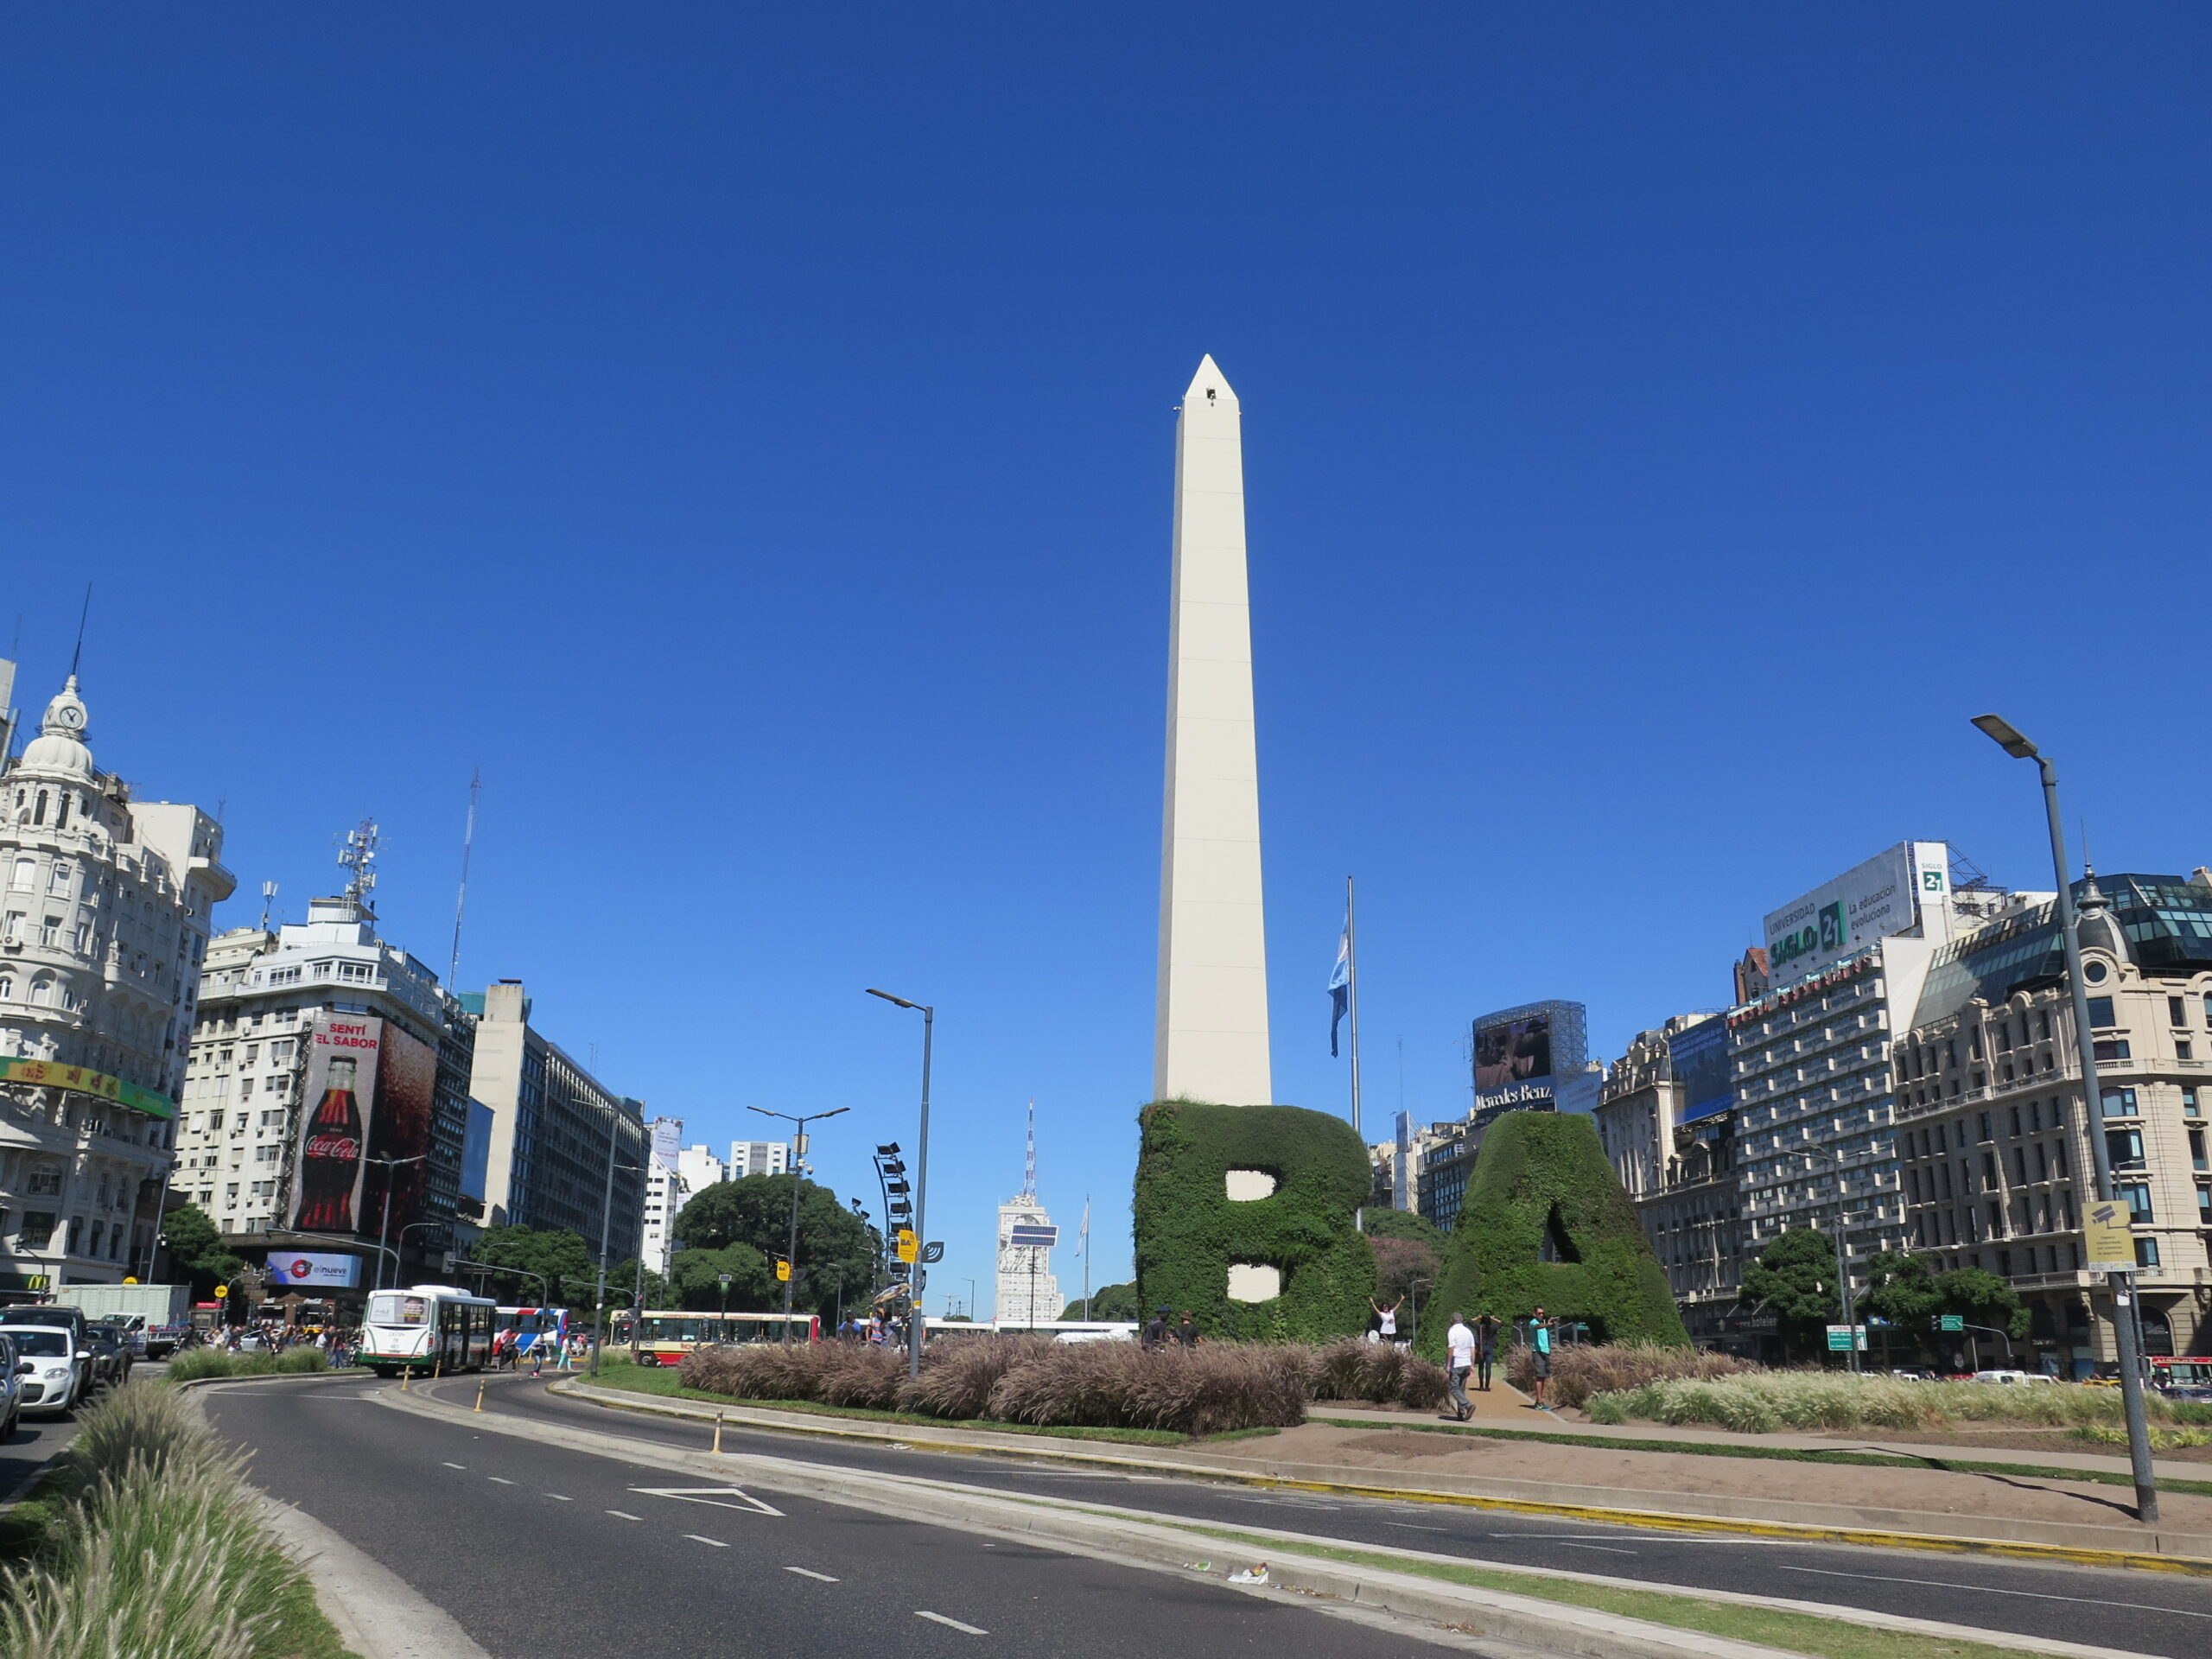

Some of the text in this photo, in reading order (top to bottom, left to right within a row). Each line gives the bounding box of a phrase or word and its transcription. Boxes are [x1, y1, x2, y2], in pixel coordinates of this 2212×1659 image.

[1926, 874, 1943, 892] 21
[1849, 885, 1895, 914] La educación
[1770, 903, 1815, 935] UNIVERSIDAD
[1851, 904, 1891, 930] evoluciona
[1770, 914, 1840, 969] SIGLO 21
[315, 1034, 378, 1049] EL SABOR
[330, 1023, 366, 1035] SENTÍ
[1476, 1084, 1552, 1111] Mercedes-Benz
[304, 1135, 360, 1158] Coca-Cola
